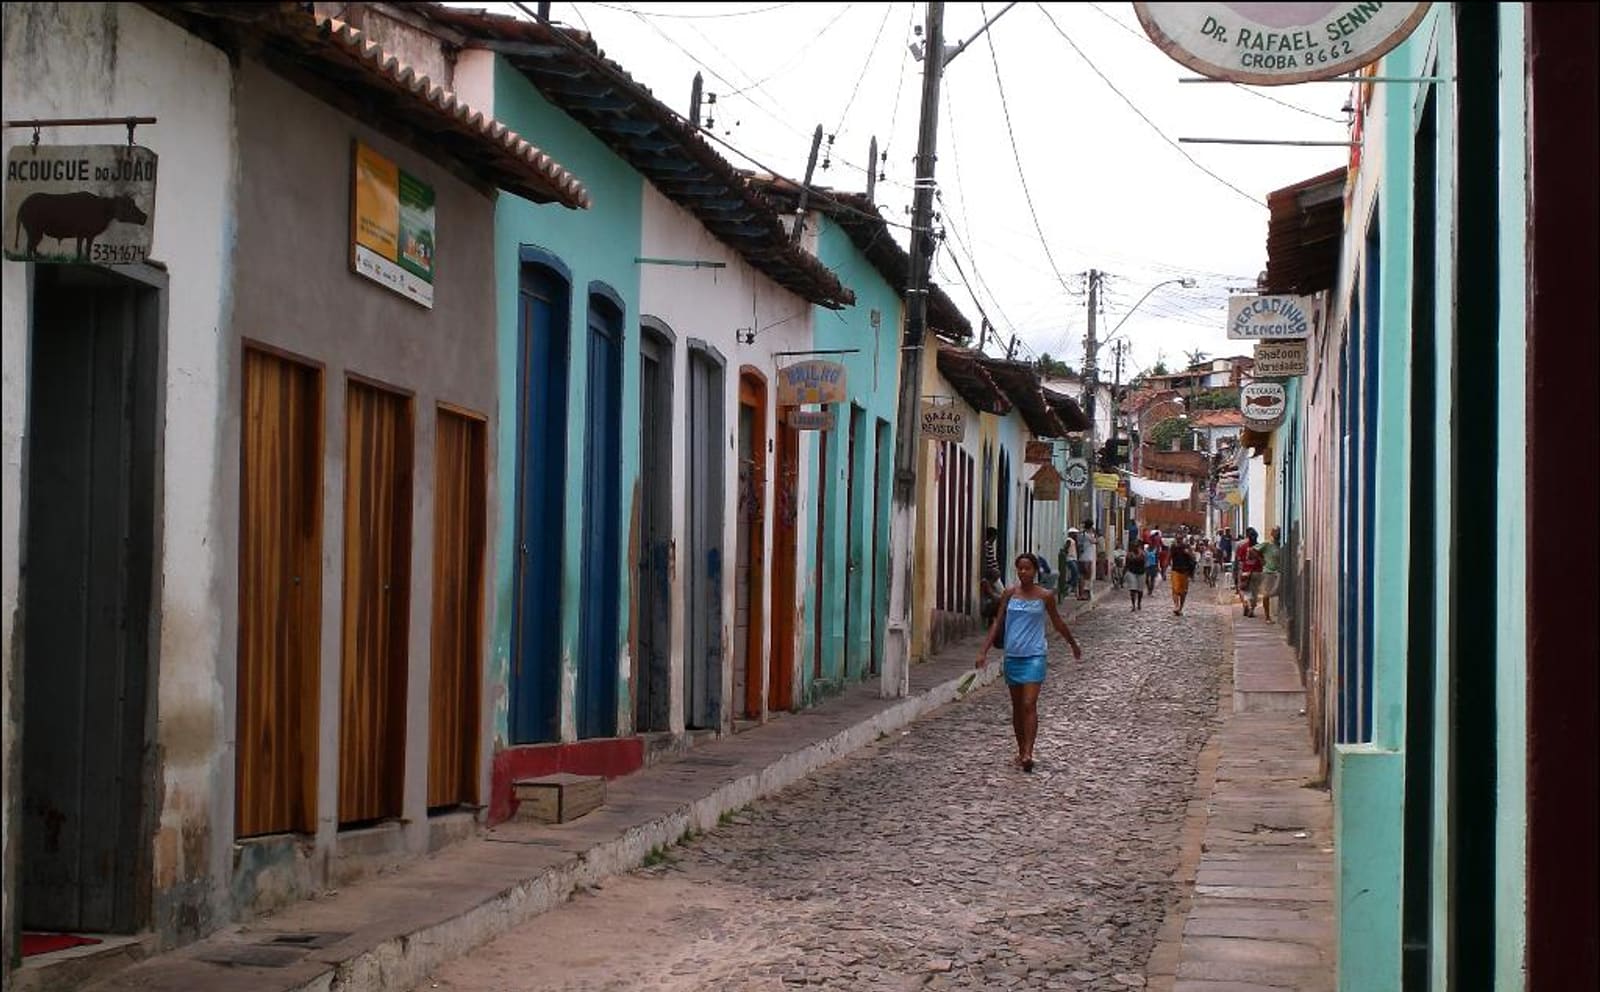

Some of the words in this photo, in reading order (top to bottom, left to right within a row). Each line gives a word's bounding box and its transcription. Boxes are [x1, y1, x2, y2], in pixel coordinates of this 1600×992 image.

[1200, 16, 1228, 43] DR.
[1236, 28, 1319, 51] RAFAEL
[1241, 52, 1297, 69] CROBA
[1304, 40, 1352, 65] 8662
[1233, 298, 1307, 336] MERCADINHO
[924, 411, 961, 424] BAZAR
